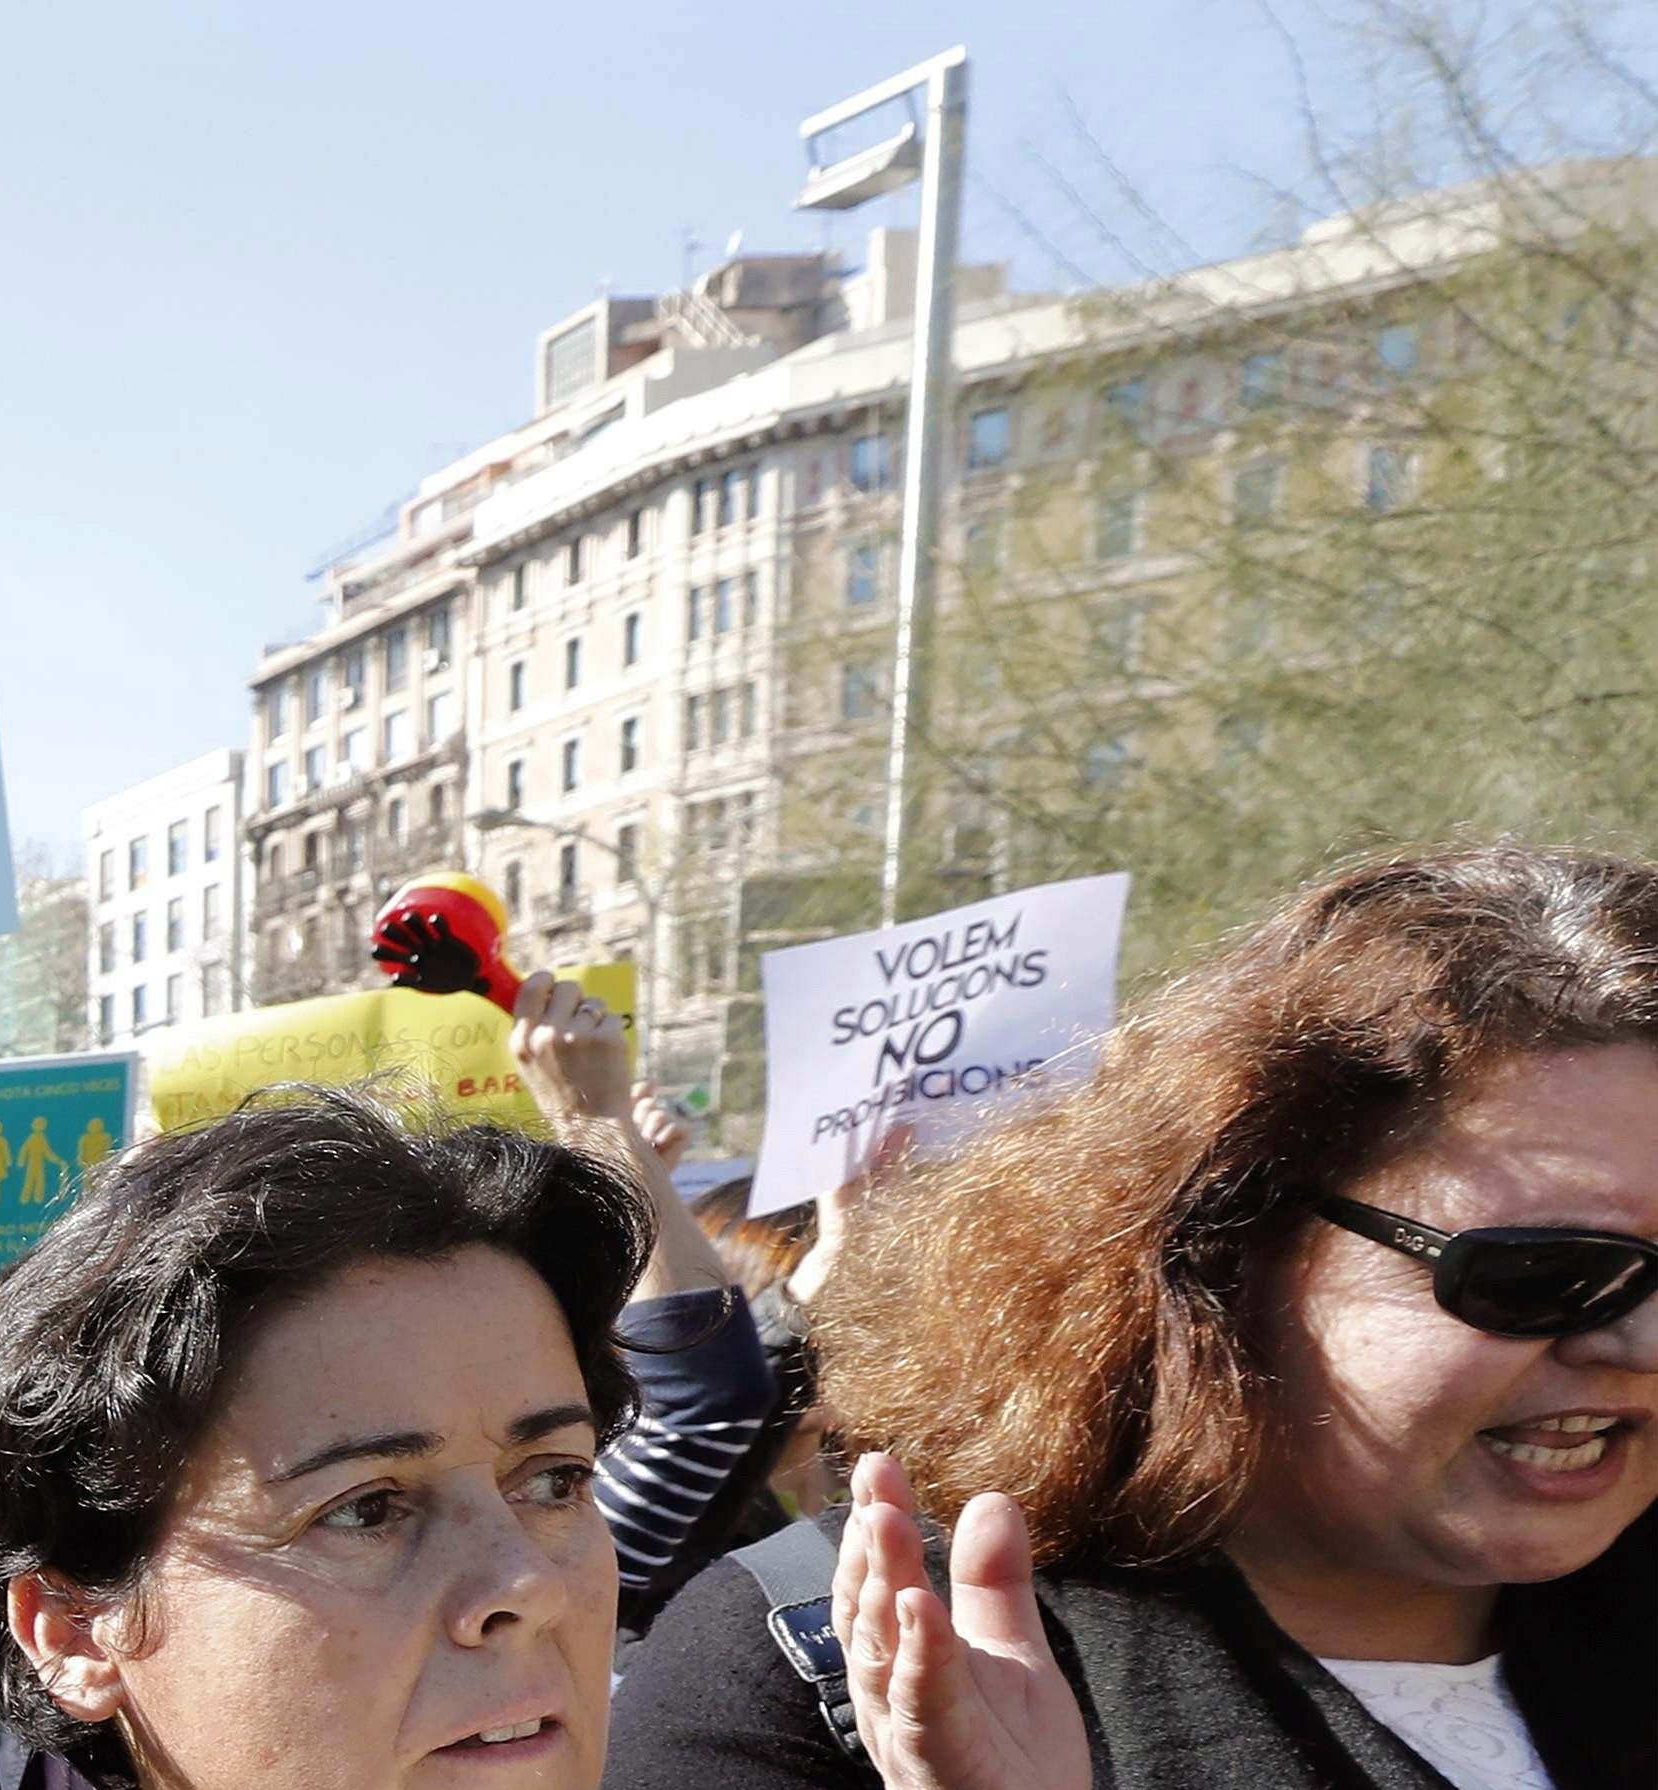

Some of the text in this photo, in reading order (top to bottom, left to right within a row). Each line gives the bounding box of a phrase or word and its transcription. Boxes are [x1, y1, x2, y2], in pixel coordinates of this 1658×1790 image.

[874, 909, 1024, 985] VOLEM
[831, 948, 1050, 1046] SOLUCIONS
[871, 1008, 965, 1089] NO
